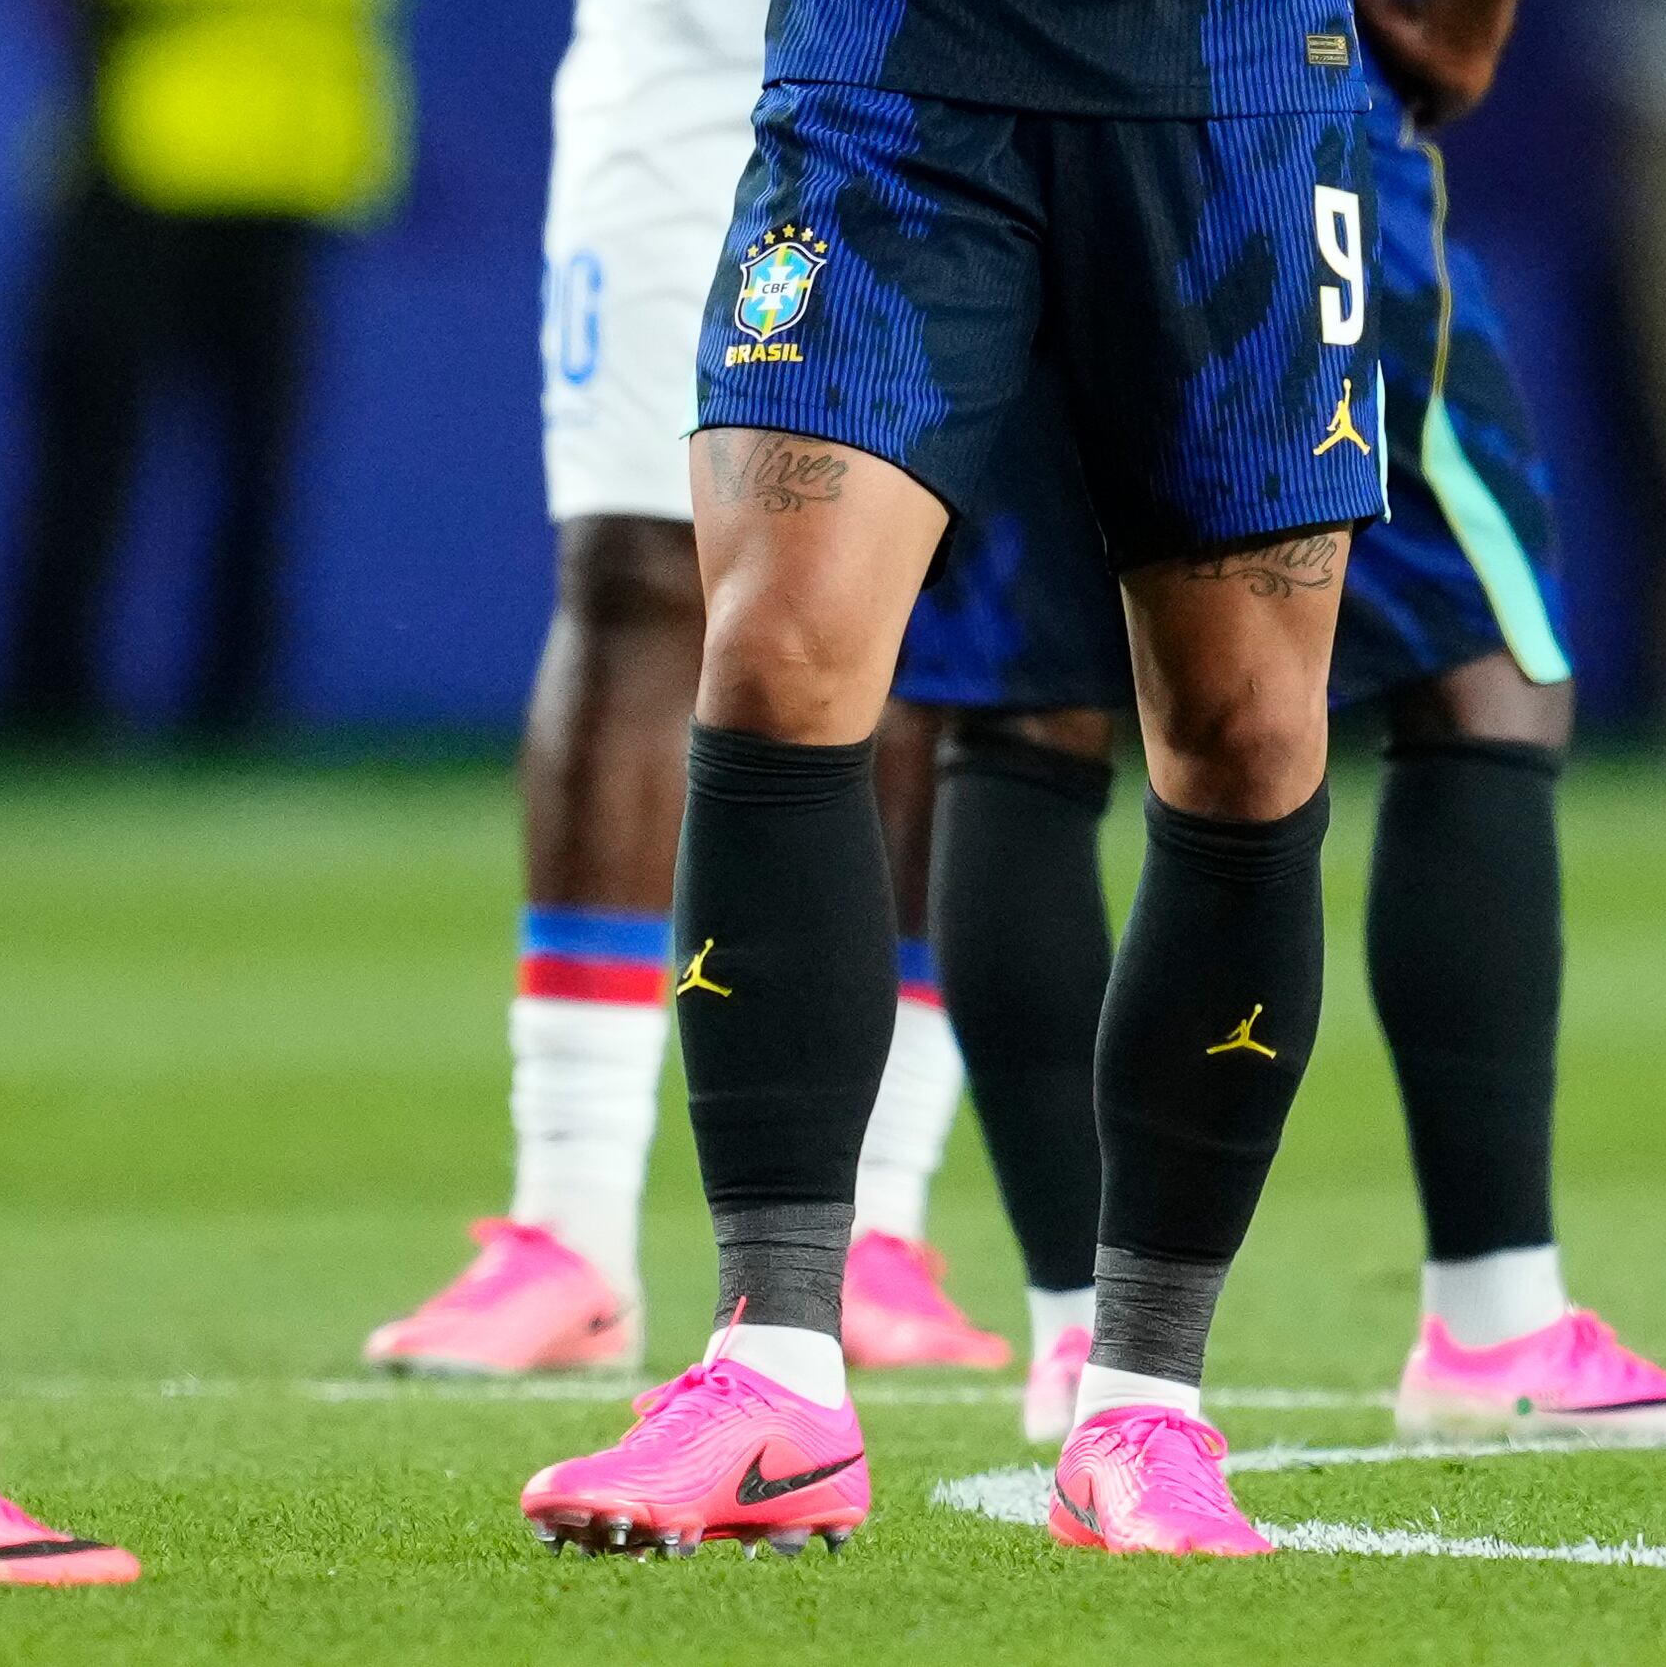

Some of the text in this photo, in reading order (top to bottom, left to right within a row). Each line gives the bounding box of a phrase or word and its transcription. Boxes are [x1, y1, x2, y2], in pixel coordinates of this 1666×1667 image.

[1313, 183, 1365, 347] 9
[761, 281, 790, 295] CBF
[724, 342, 804, 368] BRASIL
